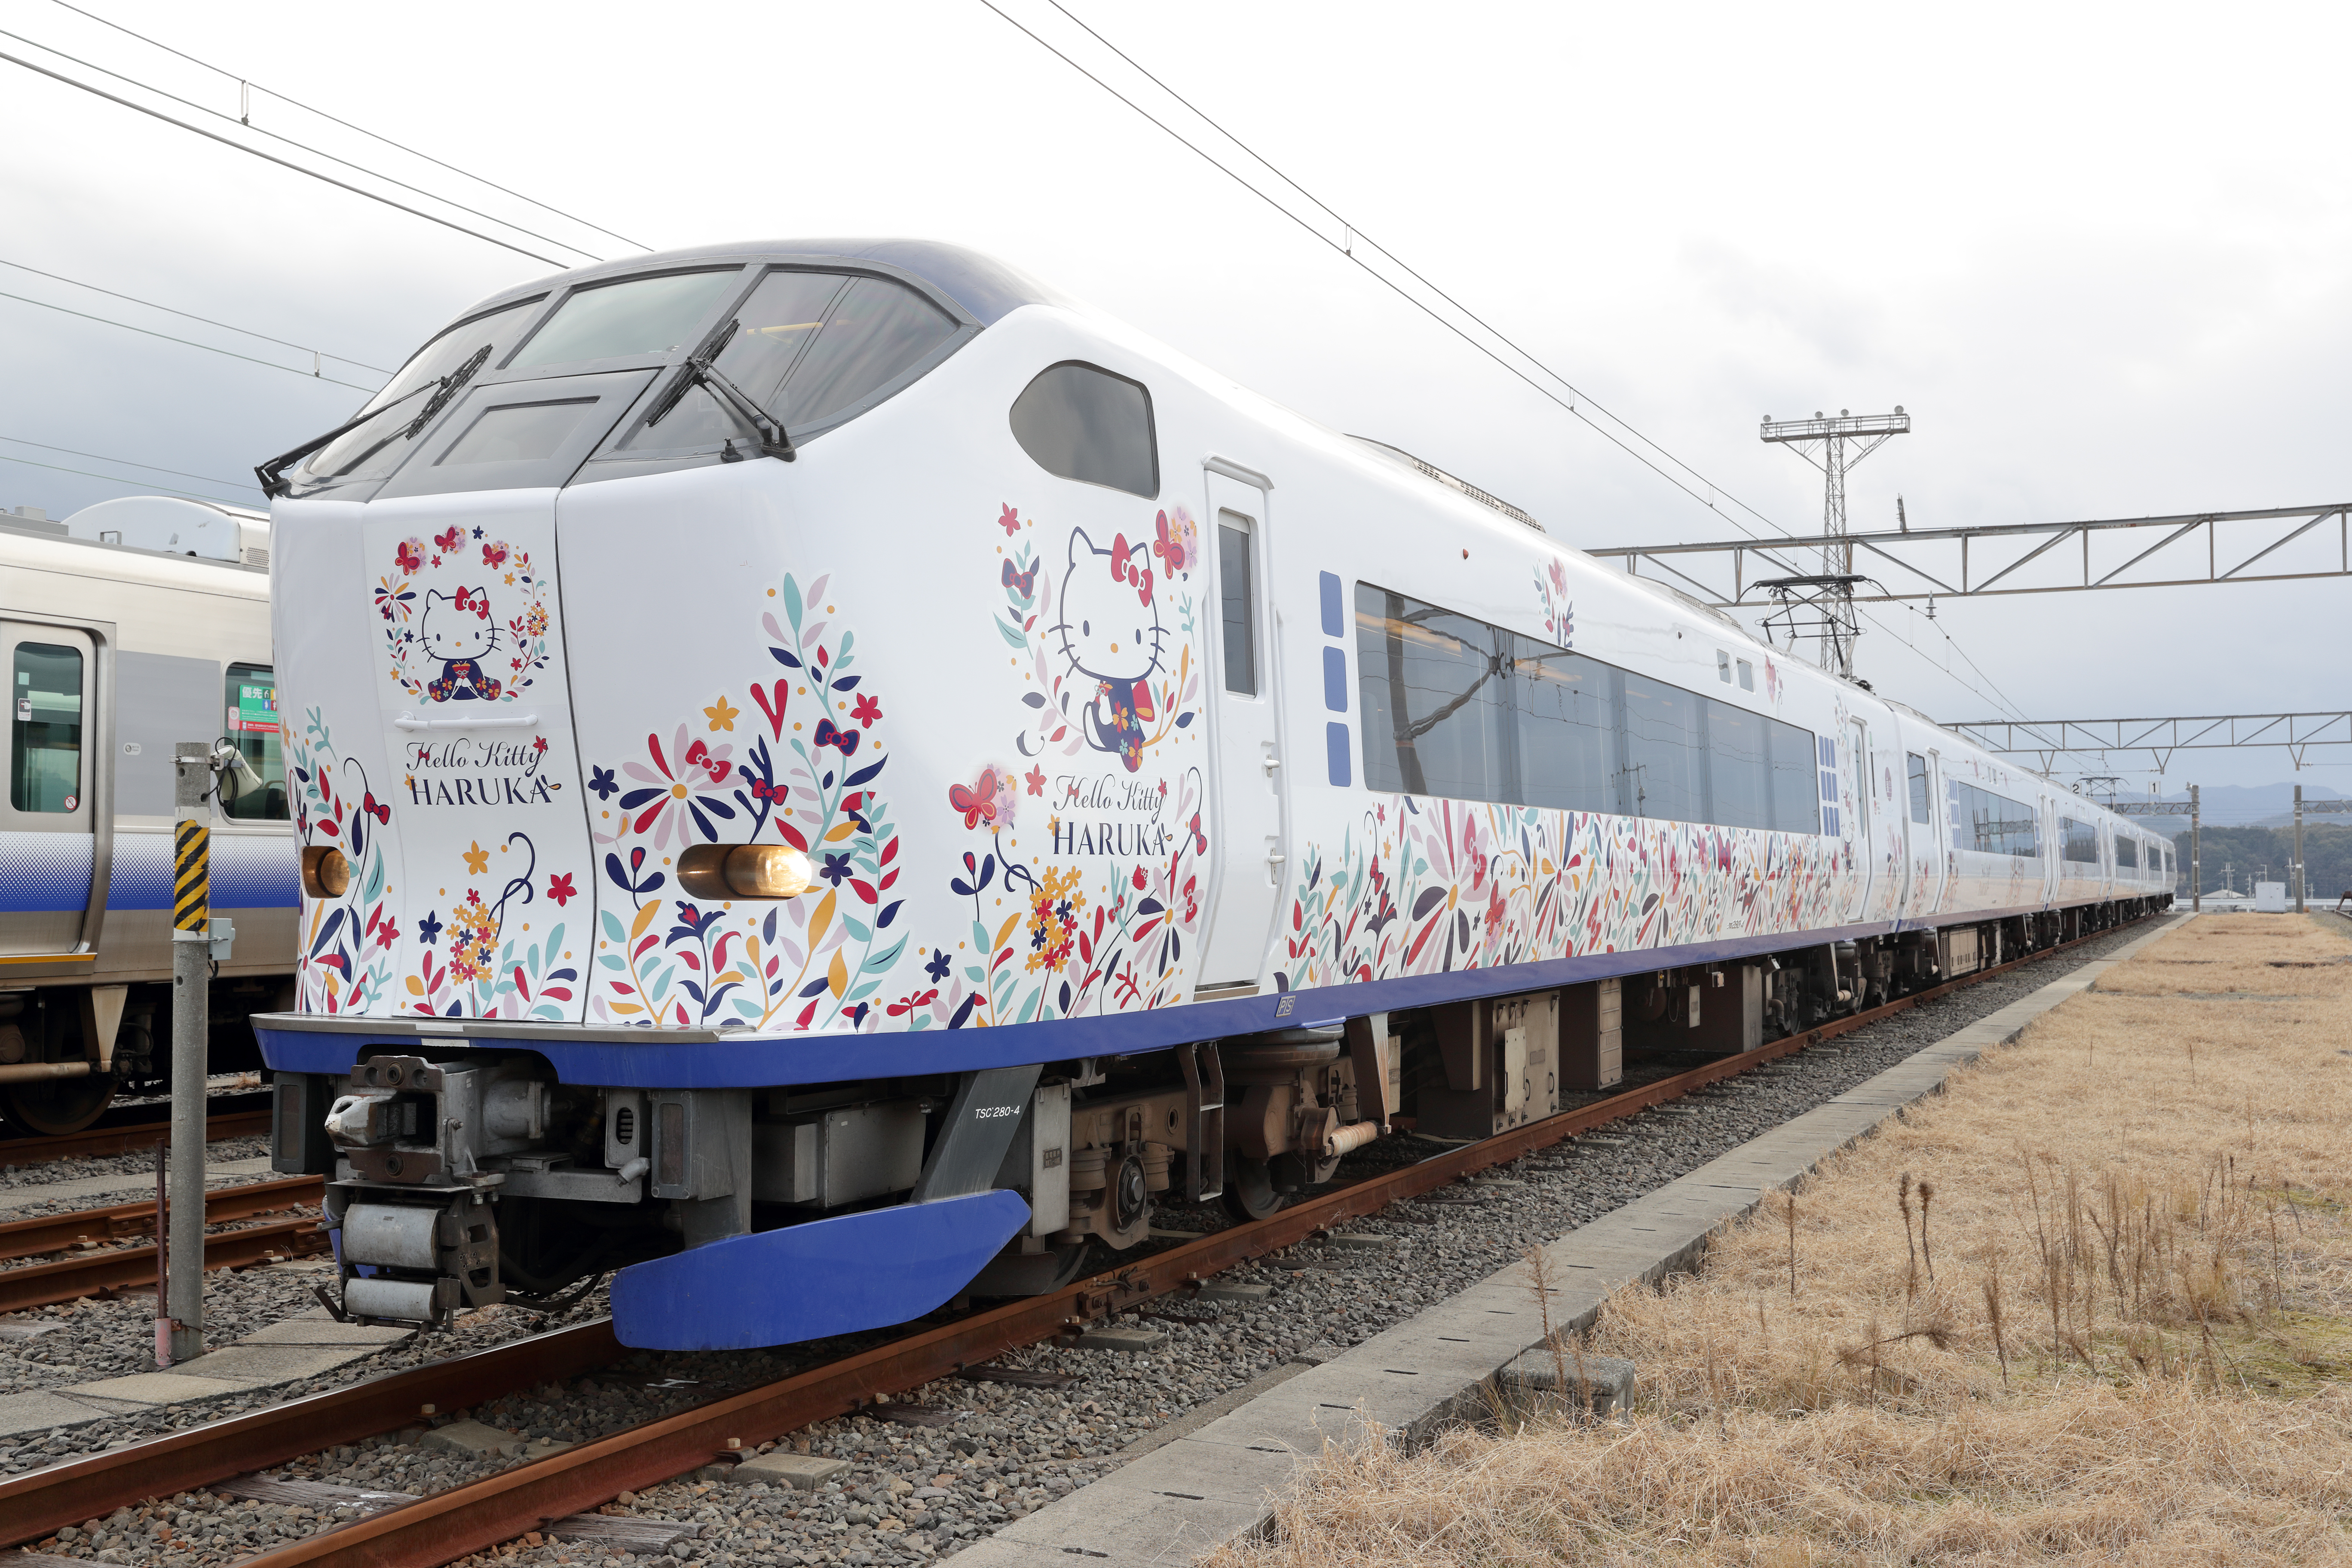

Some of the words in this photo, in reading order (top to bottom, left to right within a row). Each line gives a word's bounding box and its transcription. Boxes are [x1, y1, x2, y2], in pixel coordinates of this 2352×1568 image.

[242, 686, 262, 699] 優先
[407, 738, 471, 771] Hello
[475, 740, 548, 777] Kitty
[410, 776, 554, 805] HARUKA
[1053, 774, 1115, 811] Hello
[1118, 780, 1167, 825] Kitty
[2073, 784, 2079, 793] 2
[2152, 782, 2156, 793] 1
[1053, 821, 1167, 856] HARUKA
